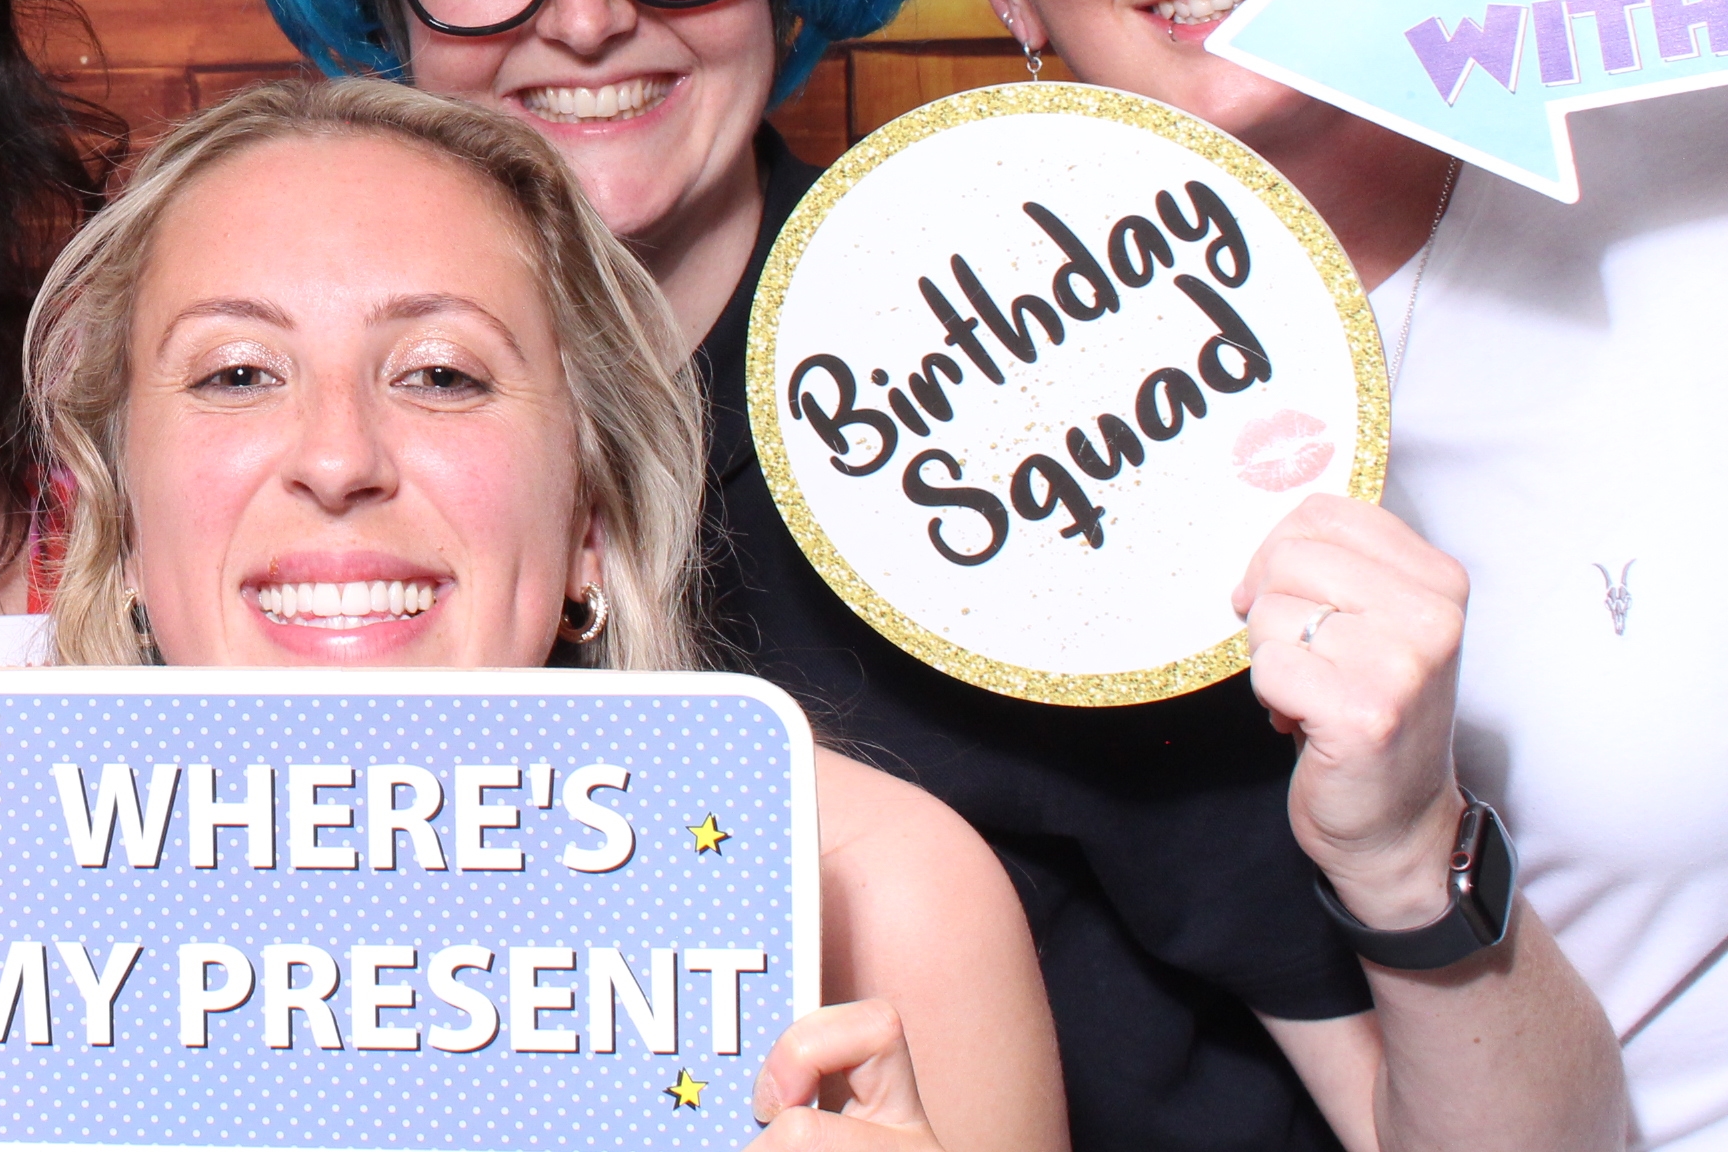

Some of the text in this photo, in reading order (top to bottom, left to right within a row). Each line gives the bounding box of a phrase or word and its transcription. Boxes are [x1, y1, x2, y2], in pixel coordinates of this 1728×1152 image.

[787, 180, 1252, 477] Birthday
[901, 273, 1273, 567] Squad
[51, 761, 636, 874] WHERE'S
[177, 942, 768, 1056] PRESENT
